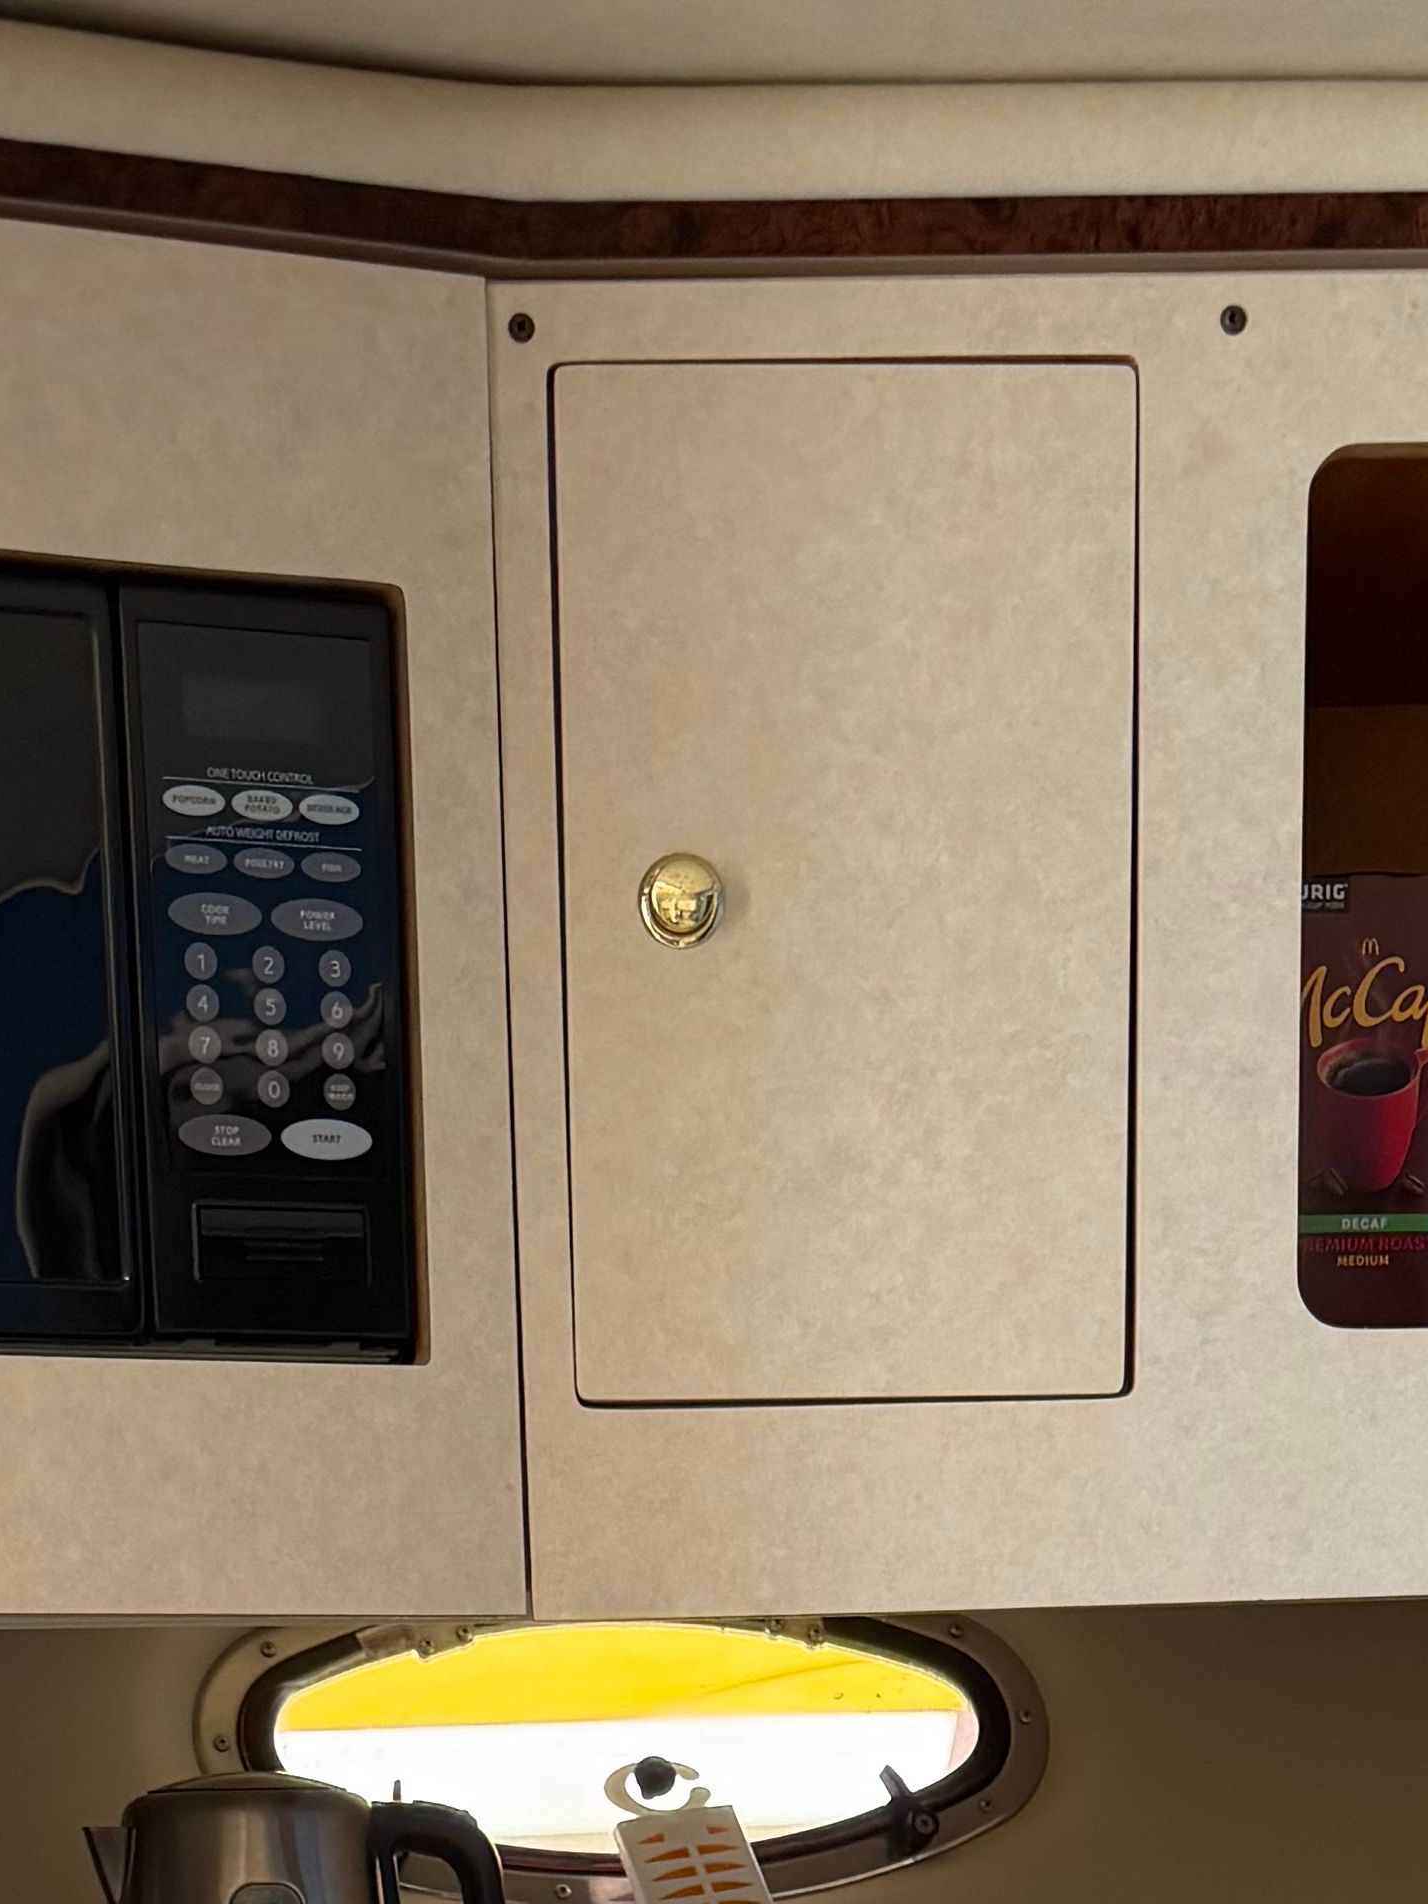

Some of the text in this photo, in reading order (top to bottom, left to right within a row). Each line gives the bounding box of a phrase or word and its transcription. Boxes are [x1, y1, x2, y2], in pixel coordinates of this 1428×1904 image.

[206, 766, 315, 785] ONE TOUCH CONTROL
[205, 825, 321, 843] AUTO WEIGHT DEFROST
[200, 903, 230, 915] COOK
[299, 909, 336, 921] POWER
[205, 914, 228, 926] TIME
[303, 920, 332, 932] LEVEL
[197, 953, 206, 971] 1
[263, 956, 275, 975] 2
[328, 960, 341, 978] 3
[197, 995, 209, 1013] 4
[264, 998, 277, 1016] 5
[331, 1001, 343, 1020] 6
[201, 1036, 211, 1054] 7
[267, 1039, 279, 1058] 8
[332, 1042, 344, 1061] 9
[268, 1081, 280, 1099] 0
[213, 1125, 240, 1136] STOP
[311, 1133, 341, 1144] START
[211, 1136, 242, 1147] CLEAR
[1340, 1217, 1389, 1231] DECAF
[1302, 1236, 1374, 1253] REMIUM
[1335, 1254, 1390, 1267] MEDIUM
